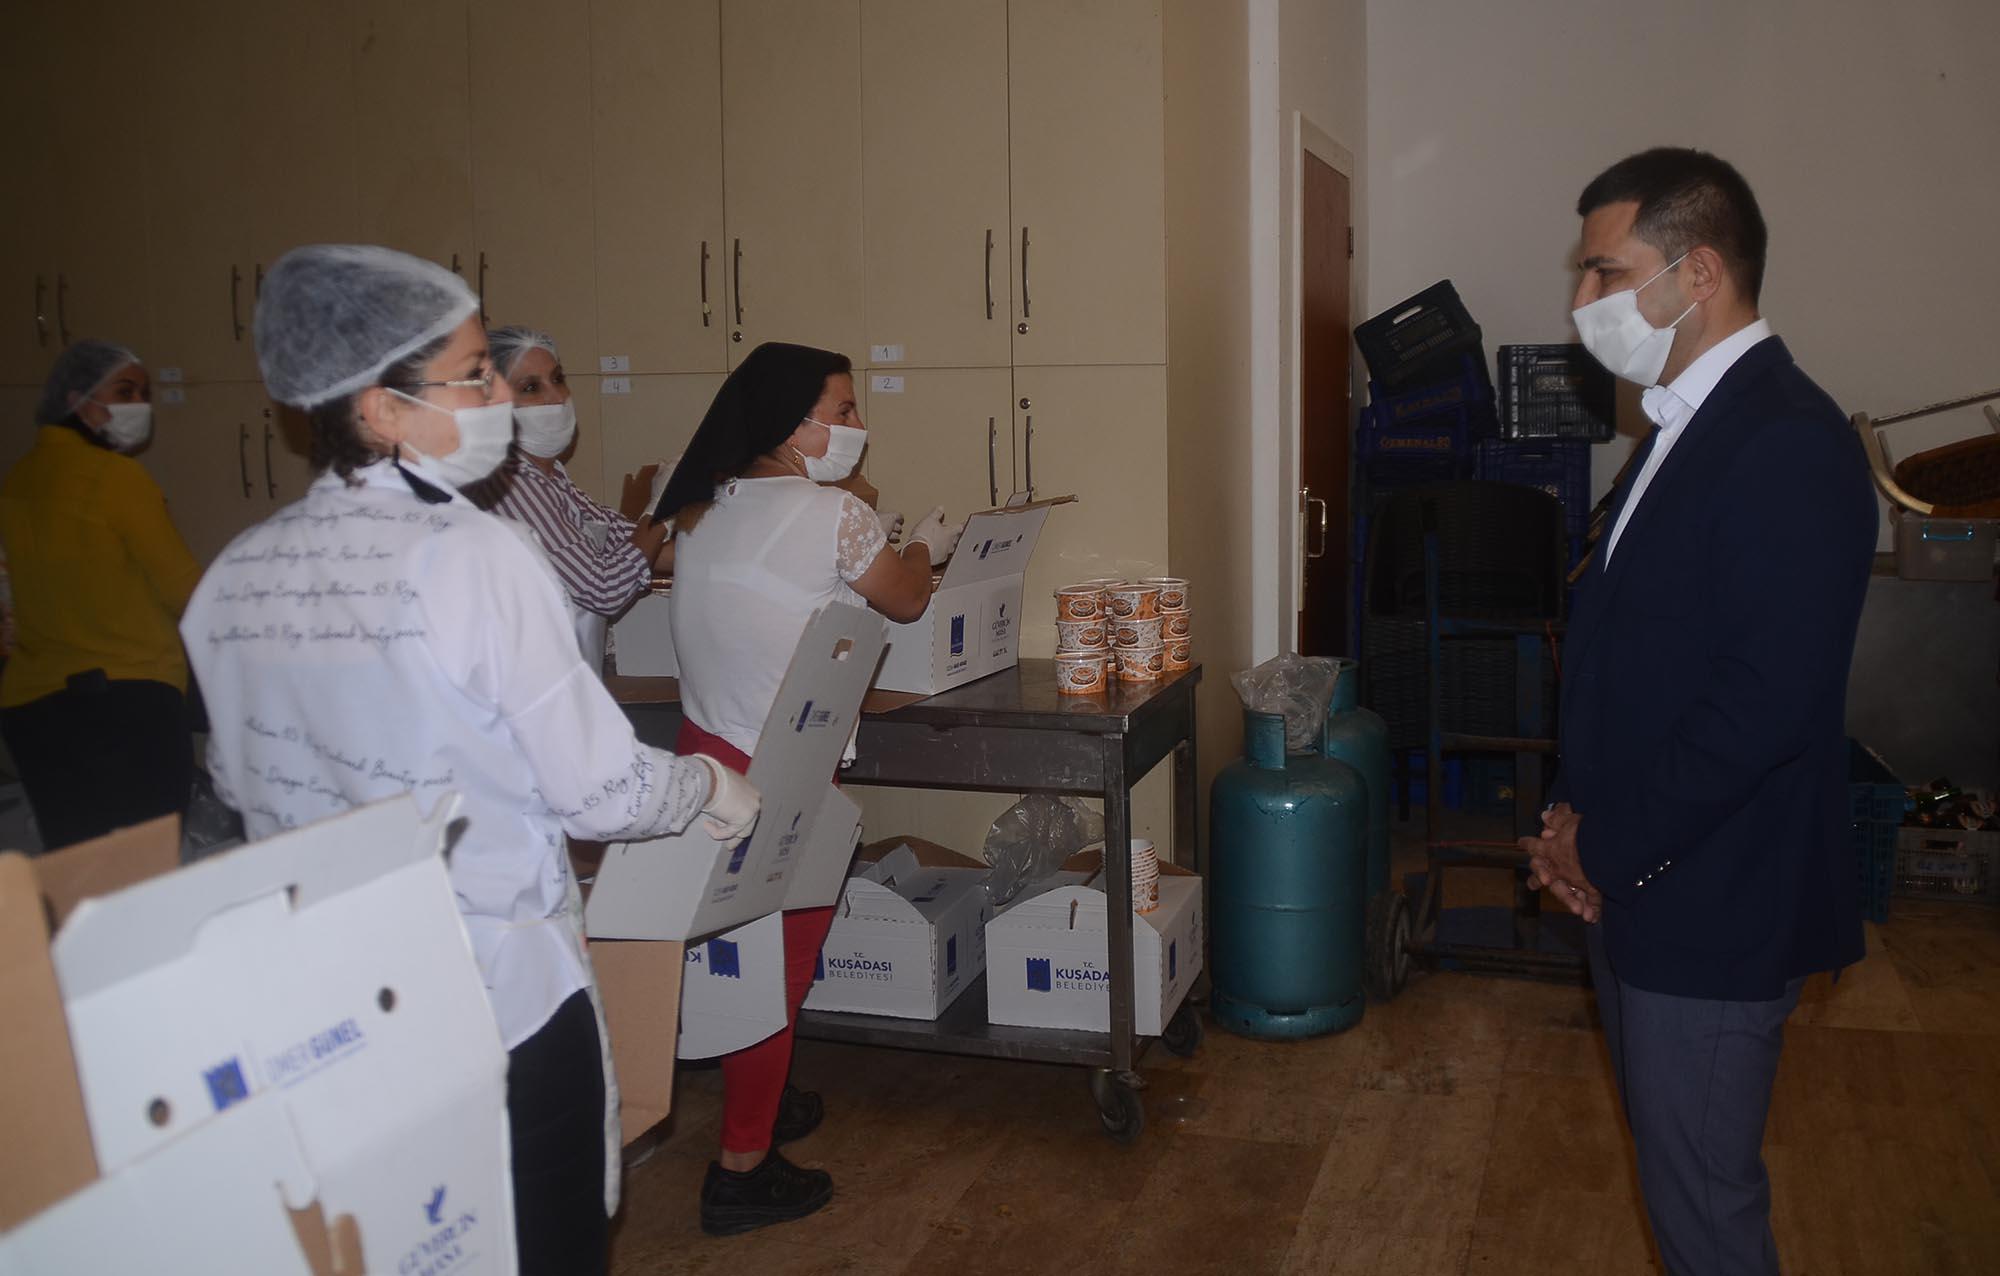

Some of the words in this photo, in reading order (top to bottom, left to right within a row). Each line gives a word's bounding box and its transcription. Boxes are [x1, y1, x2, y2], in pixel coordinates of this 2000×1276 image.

[608, 356, 617, 369] 3
[883, 377, 894, 389] 2
[828, 957, 892, 972] KUŞADASI
[1055, 968, 1110, 981] KUŞADA
